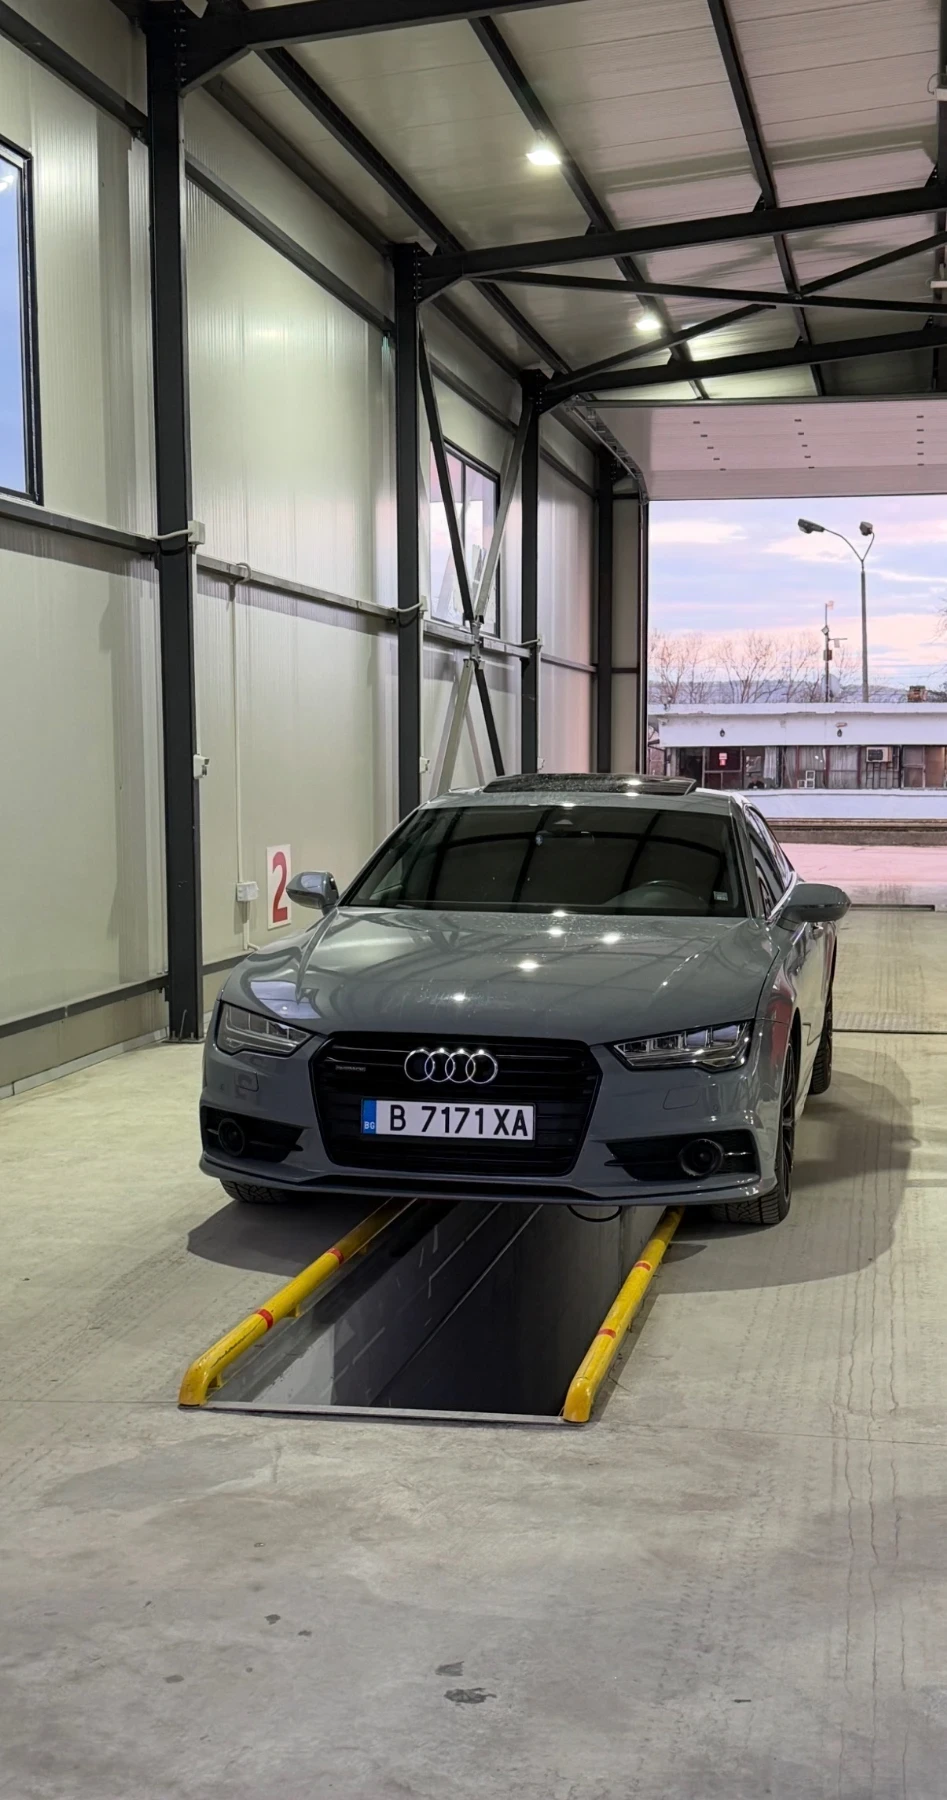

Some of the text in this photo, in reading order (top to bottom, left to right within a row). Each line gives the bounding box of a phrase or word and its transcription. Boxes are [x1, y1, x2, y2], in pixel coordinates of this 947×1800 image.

[272, 851, 288, 923] 2
[364, 1121, 375, 1130] BG
[390, 1104, 528, 1136] B 7171 XA
